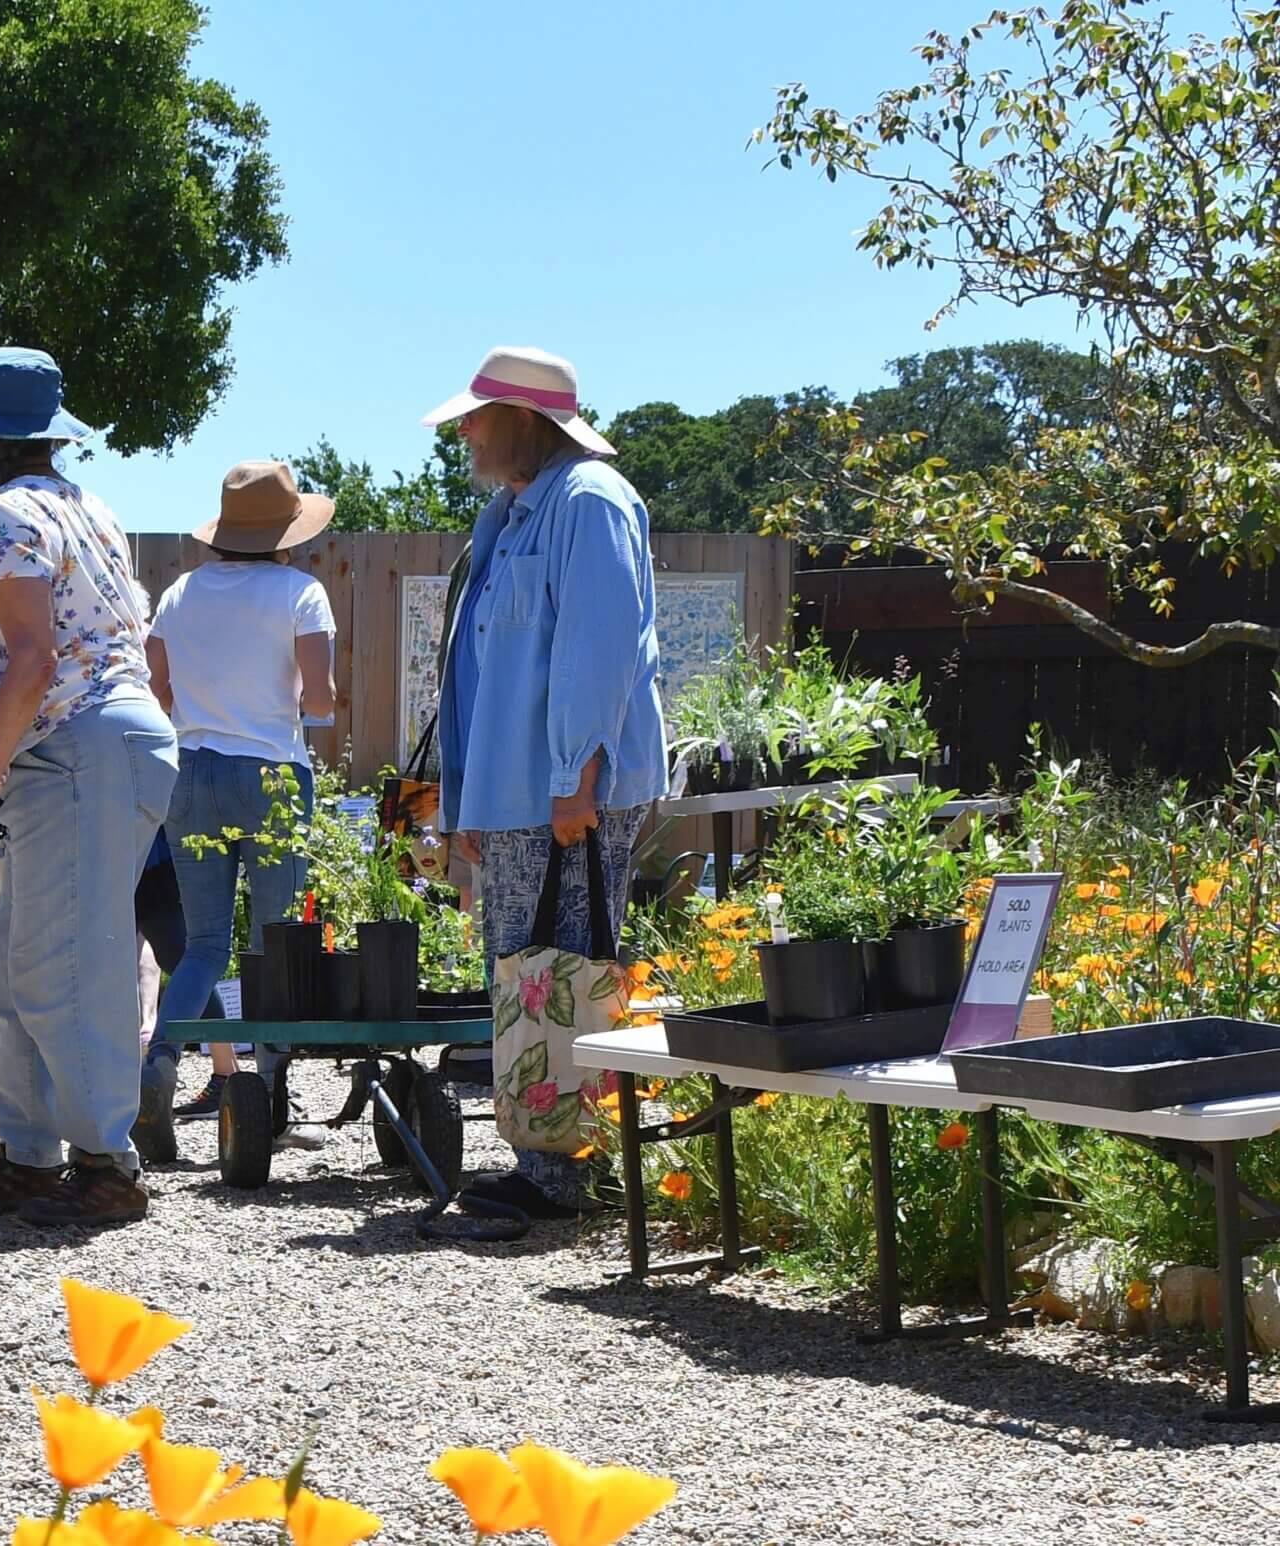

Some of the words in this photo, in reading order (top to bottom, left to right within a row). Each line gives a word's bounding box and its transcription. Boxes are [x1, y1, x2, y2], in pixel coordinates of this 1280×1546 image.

[1007, 899, 1031, 911] SOLD
[999, 920, 1032, 932] PLANTS
[977, 960, 1001, 973] HOLD
[1002, 960, 1025, 973] AREA
